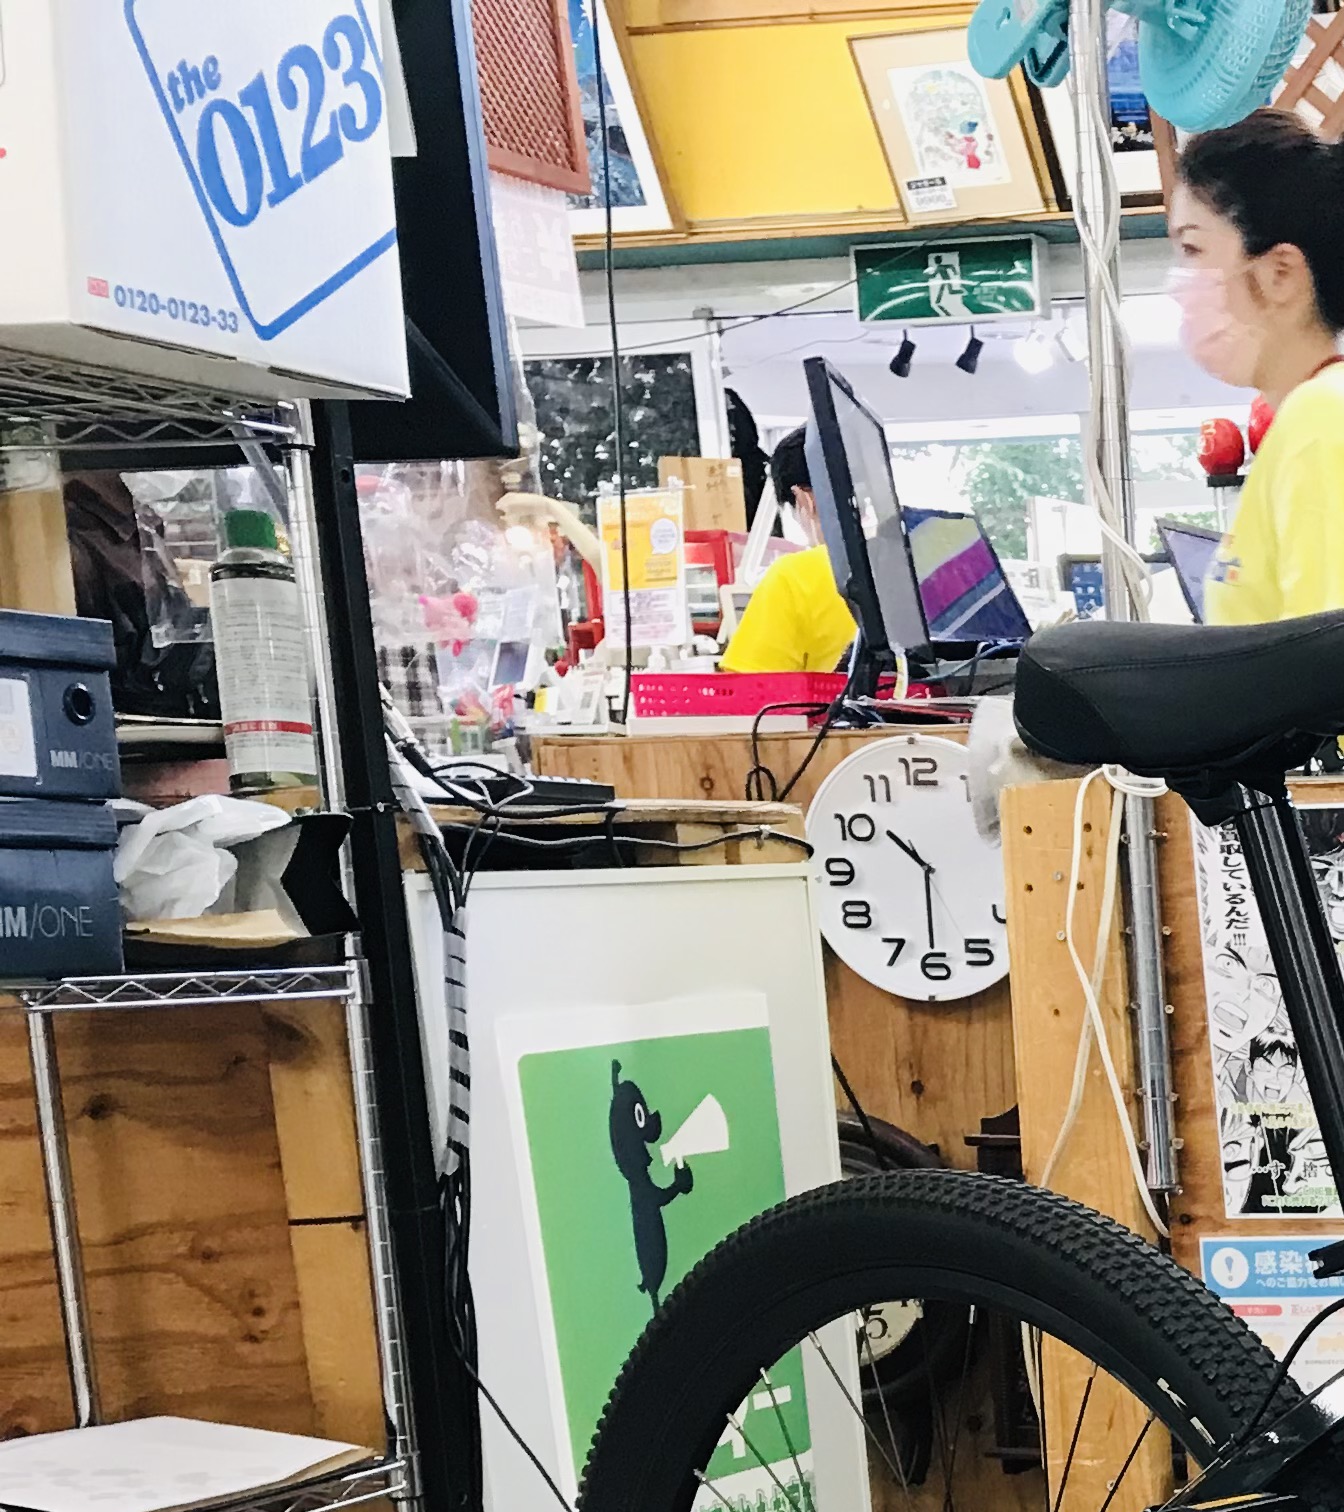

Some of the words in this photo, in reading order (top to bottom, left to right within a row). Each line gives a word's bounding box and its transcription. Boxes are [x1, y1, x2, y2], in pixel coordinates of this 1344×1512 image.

[168, 55, 221, 115] the
[198, 14, 382, 228] 0123
[114, 285, 240, 334] 0120-0123-33
[898, 757, 939, 786] 12
[863, 774, 892, 803] 11
[834, 813, 876, 842] 10
[825, 857, 855, 886] 9
[0, 905, 94, 939] M/ONE
[841, 900, 872, 929] 8
[881, 937, 906, 967] 7
[920, 951, 952, 981] 6
[964, 938, 995, 966] 5
